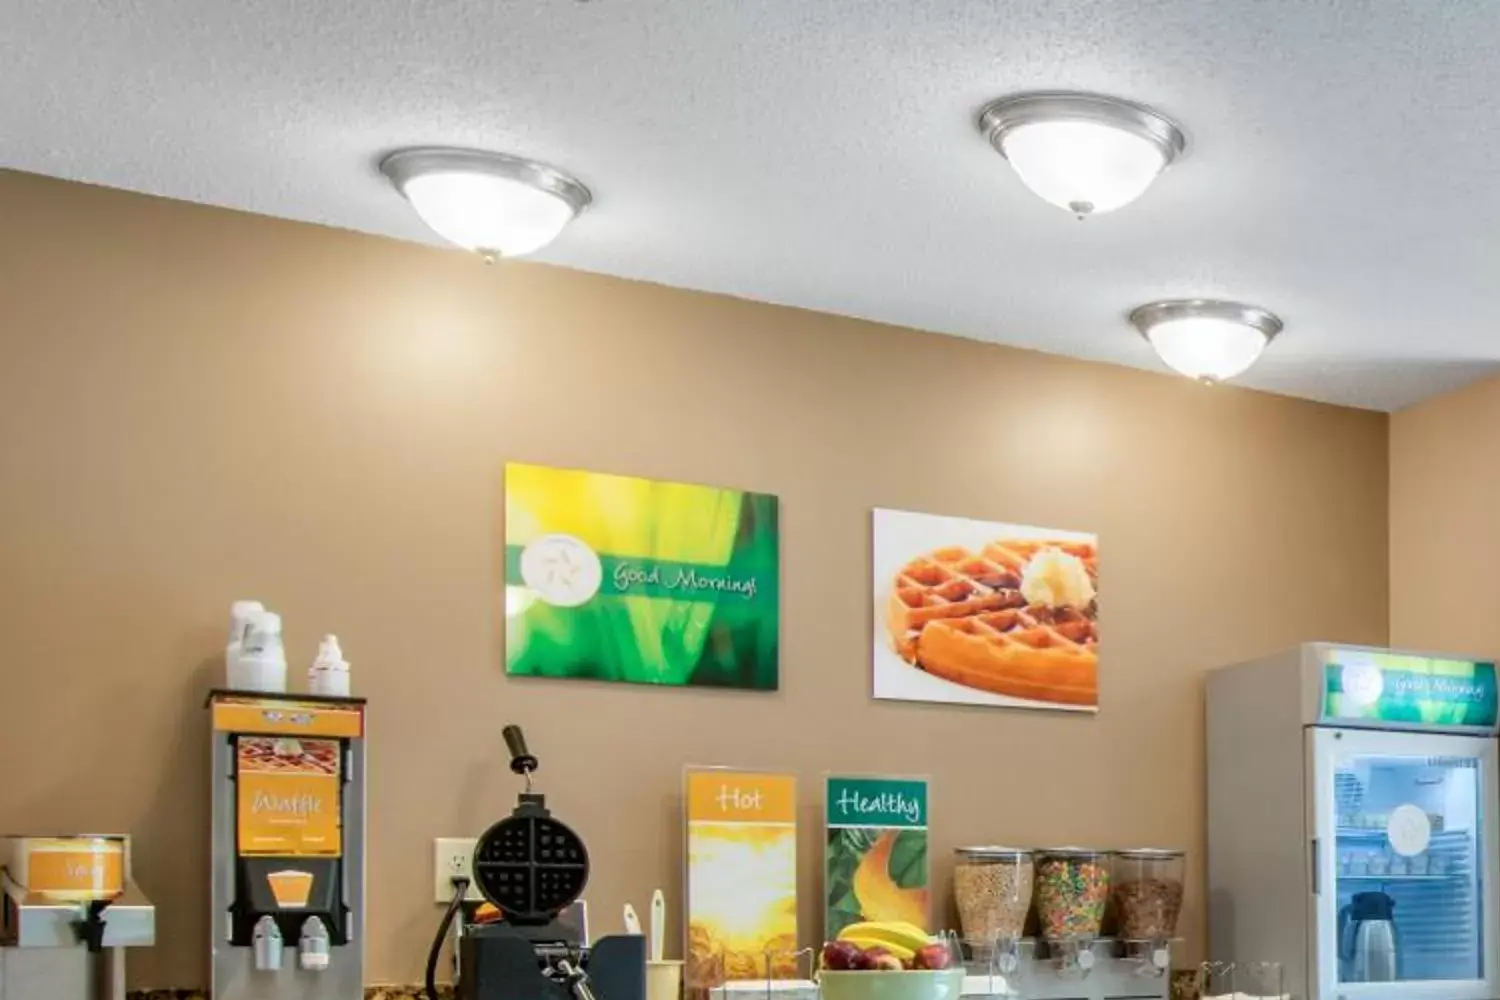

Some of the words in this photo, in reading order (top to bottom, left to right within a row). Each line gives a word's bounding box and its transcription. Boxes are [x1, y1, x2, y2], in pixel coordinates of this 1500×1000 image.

[613, 561, 660, 592] Good
[664, 568, 757, 600] Morning!
[716, 783, 764, 812] Hot
[836, 787, 920, 823] Healthy
